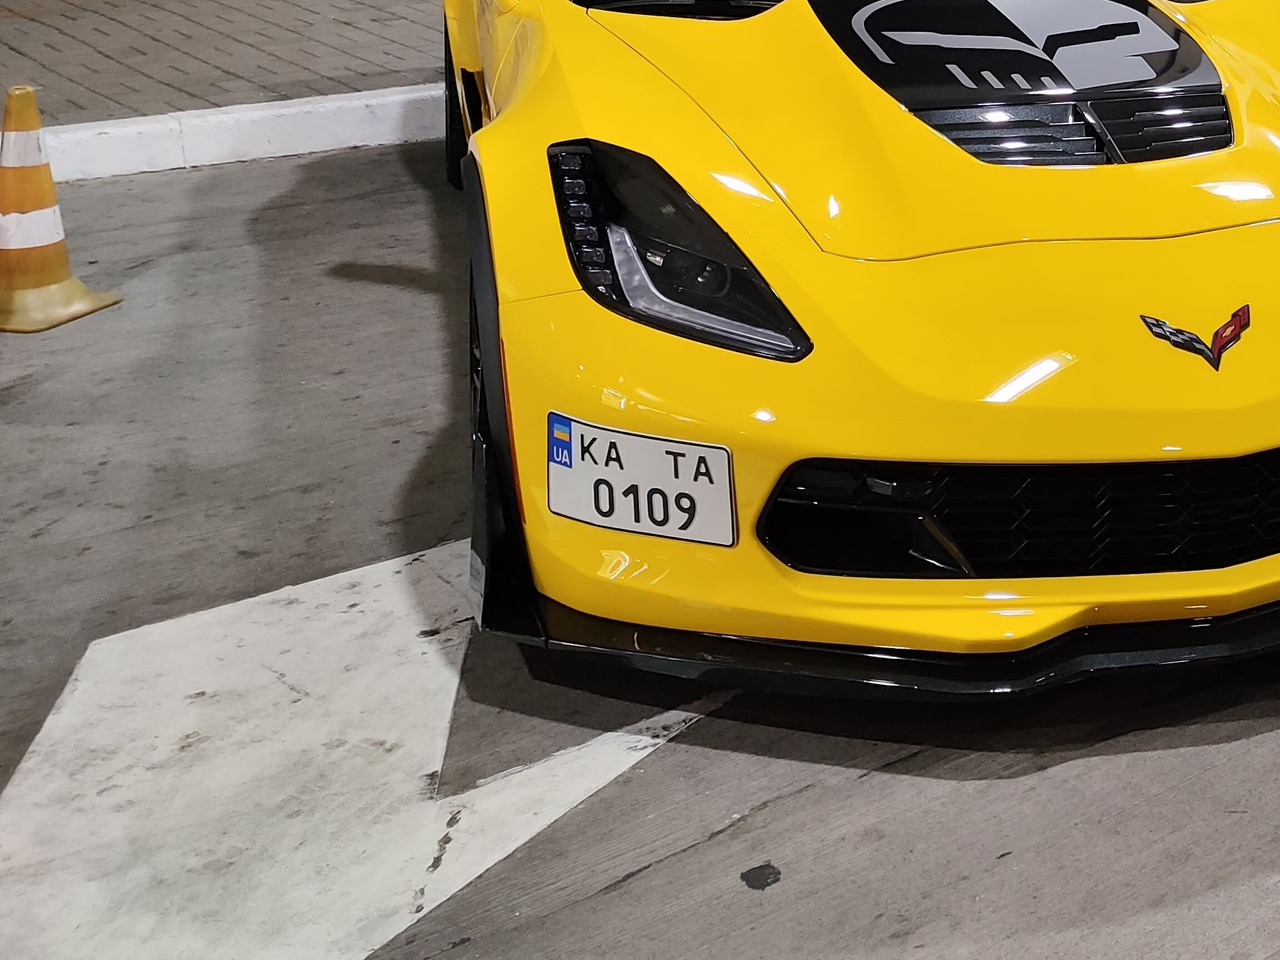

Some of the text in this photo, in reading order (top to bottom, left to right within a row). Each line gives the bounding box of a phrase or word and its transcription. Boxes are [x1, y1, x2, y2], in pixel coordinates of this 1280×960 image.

[553, 445, 571, 466] UA
[579, 433, 715, 485] KA TA
[593, 478, 696, 531] 0109
